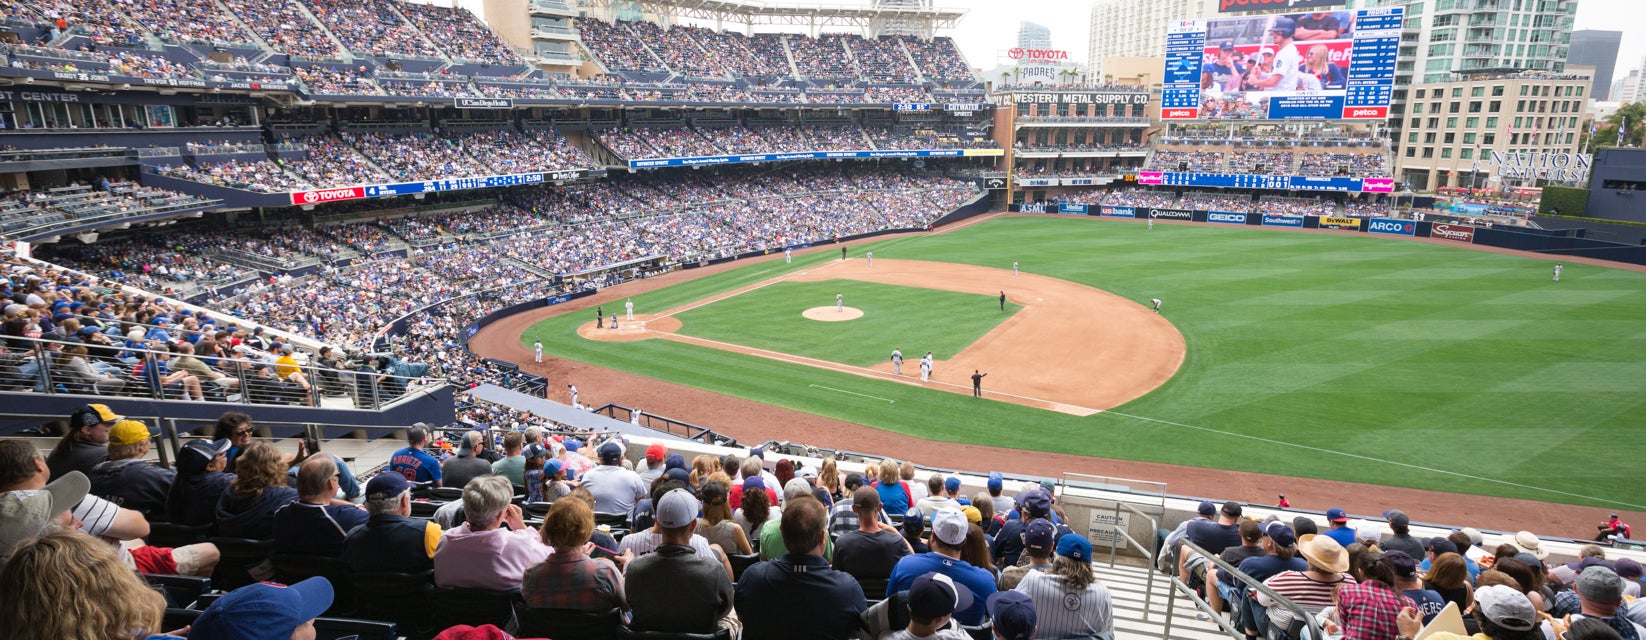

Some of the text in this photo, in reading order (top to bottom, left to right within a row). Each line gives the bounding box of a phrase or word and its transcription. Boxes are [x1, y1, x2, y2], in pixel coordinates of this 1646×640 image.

[1027, 50, 1068, 59] TOYOTA
[1023, 67, 1054, 79] PADRES
[21, 92, 79, 102] CENTER
[1014, 93, 1149, 104] WESTERN METAL SUPPLY CO.
[1490, 151, 1593, 168] NATION
[319, 189, 355, 200] TOYOTA
[1151, 210, 1191, 219] QUALCOMM
[1370, 221, 1402, 231] ARCO
[1436, 225, 1468, 238] Sycuan
